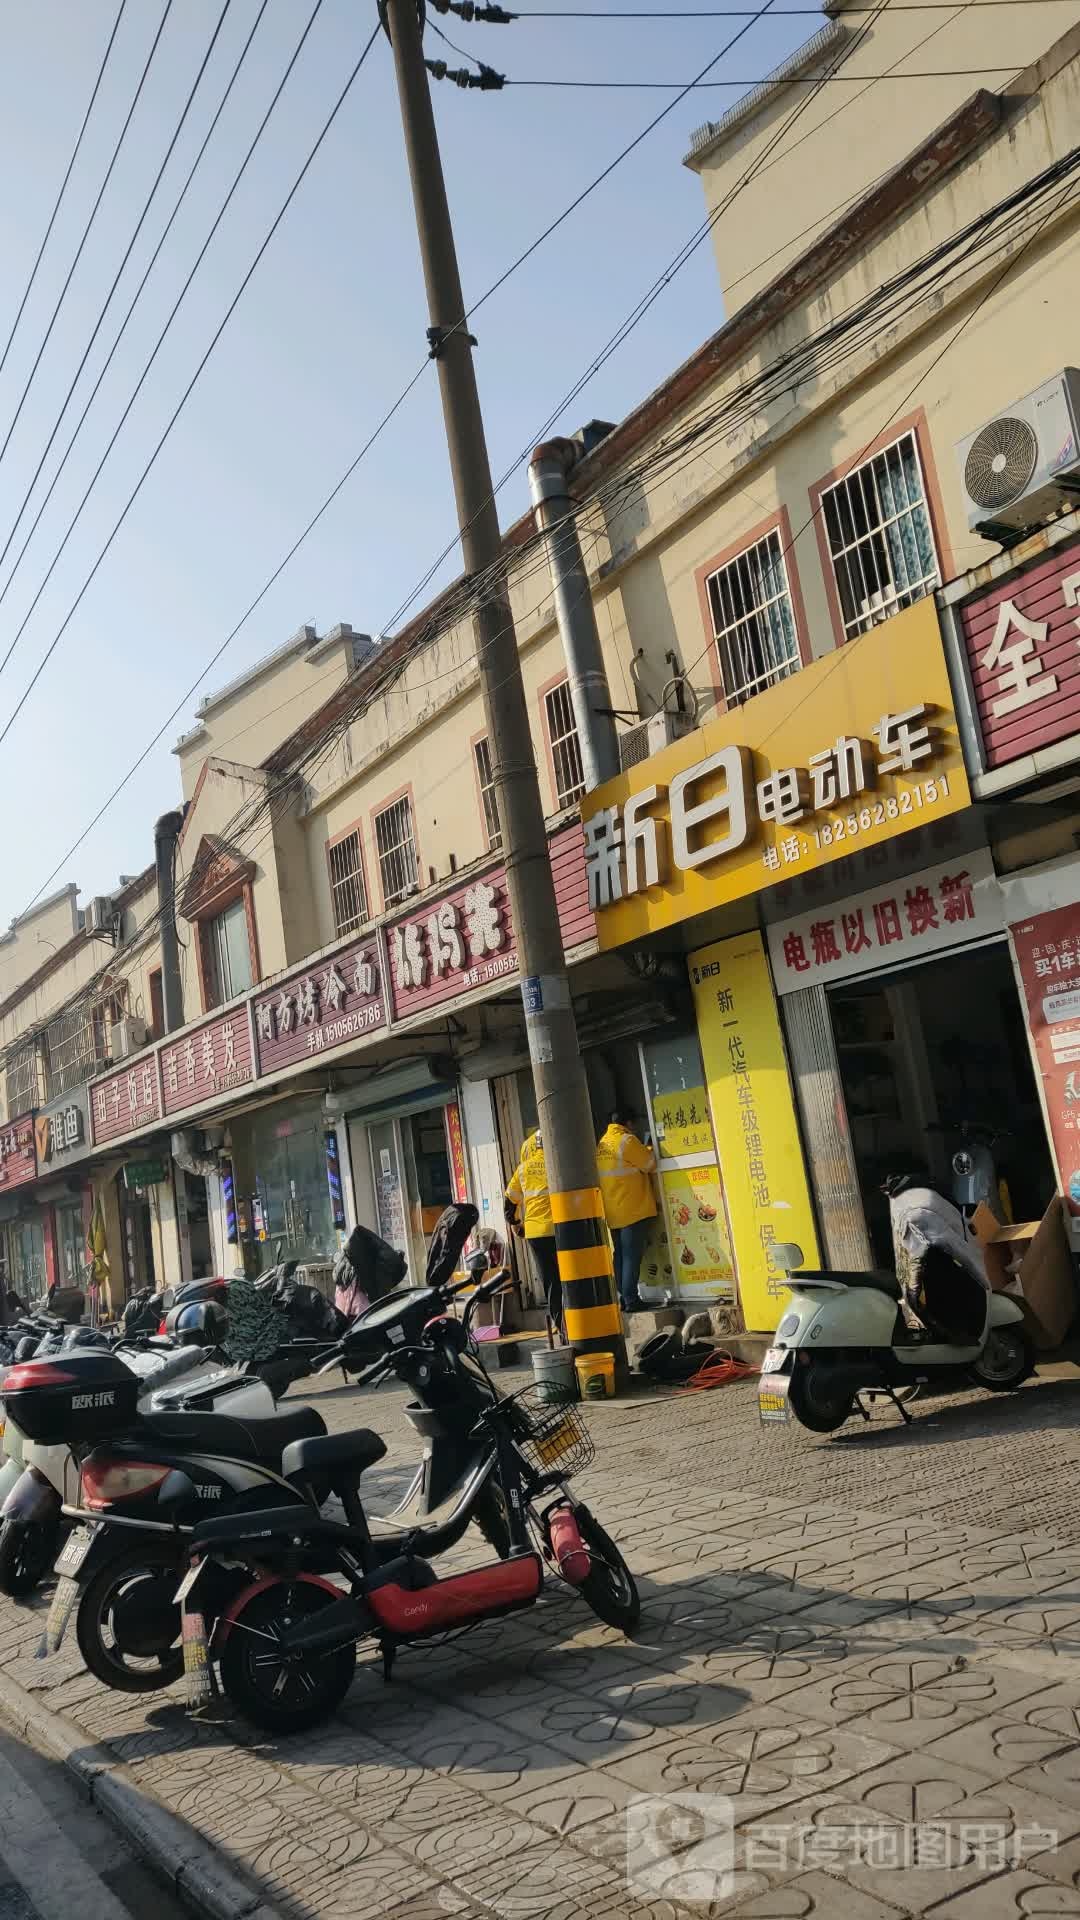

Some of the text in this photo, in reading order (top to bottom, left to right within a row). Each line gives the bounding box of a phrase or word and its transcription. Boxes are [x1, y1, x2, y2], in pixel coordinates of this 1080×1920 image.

[982, 571, 1080, 719] 全
[783, 870, 975, 974] 电瓶以旧换新
[256, 949, 379, 1041] 阿方烤冷面
[166, 1020, 239, 1095] 吉香美发
[716, 987, 772, 1209] 新一代汽车级锂电池
[49, 1105, 80, 1153] 雅迪
[72, 1391, 115, 1410] 欧派
